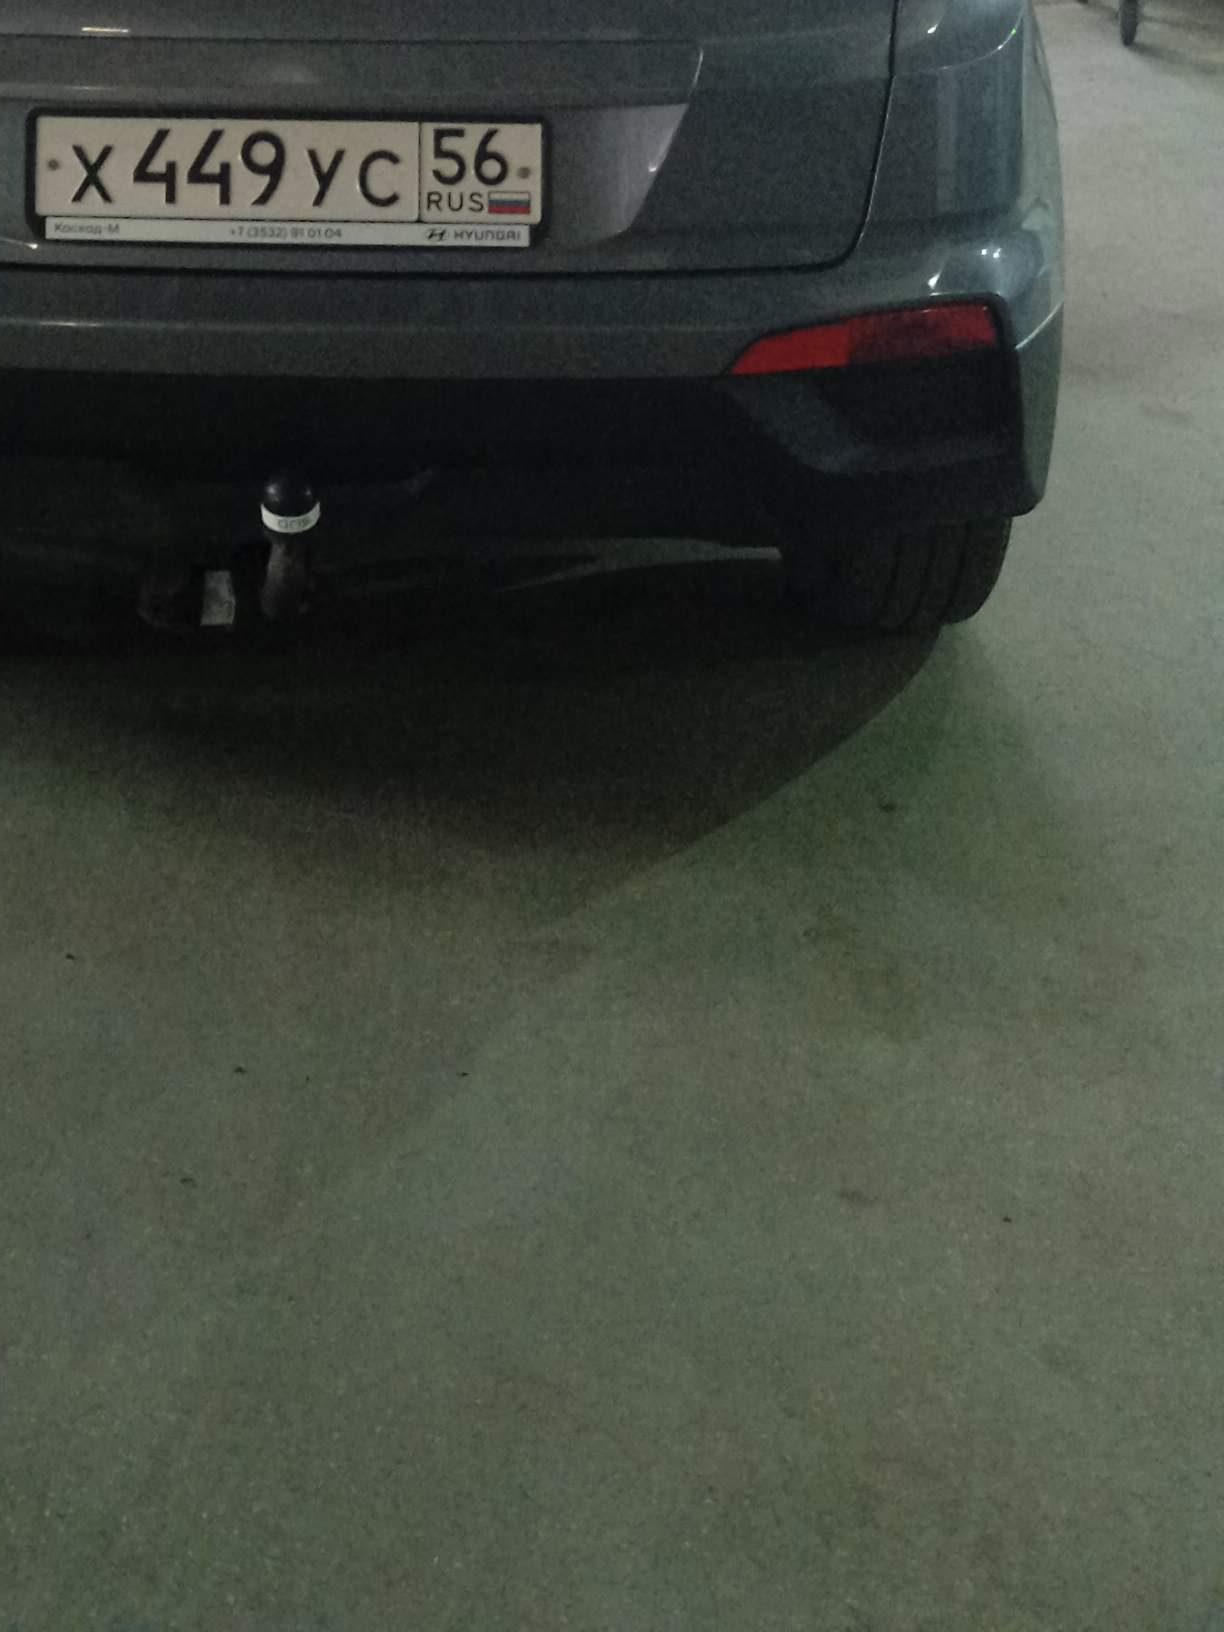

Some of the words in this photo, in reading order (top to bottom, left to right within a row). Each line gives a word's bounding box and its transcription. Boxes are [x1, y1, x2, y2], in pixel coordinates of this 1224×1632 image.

[432, 128, 508, 186] 56
[426, 191, 485, 212] RUS
[454, 229, 522, 242] HYUNDAI
